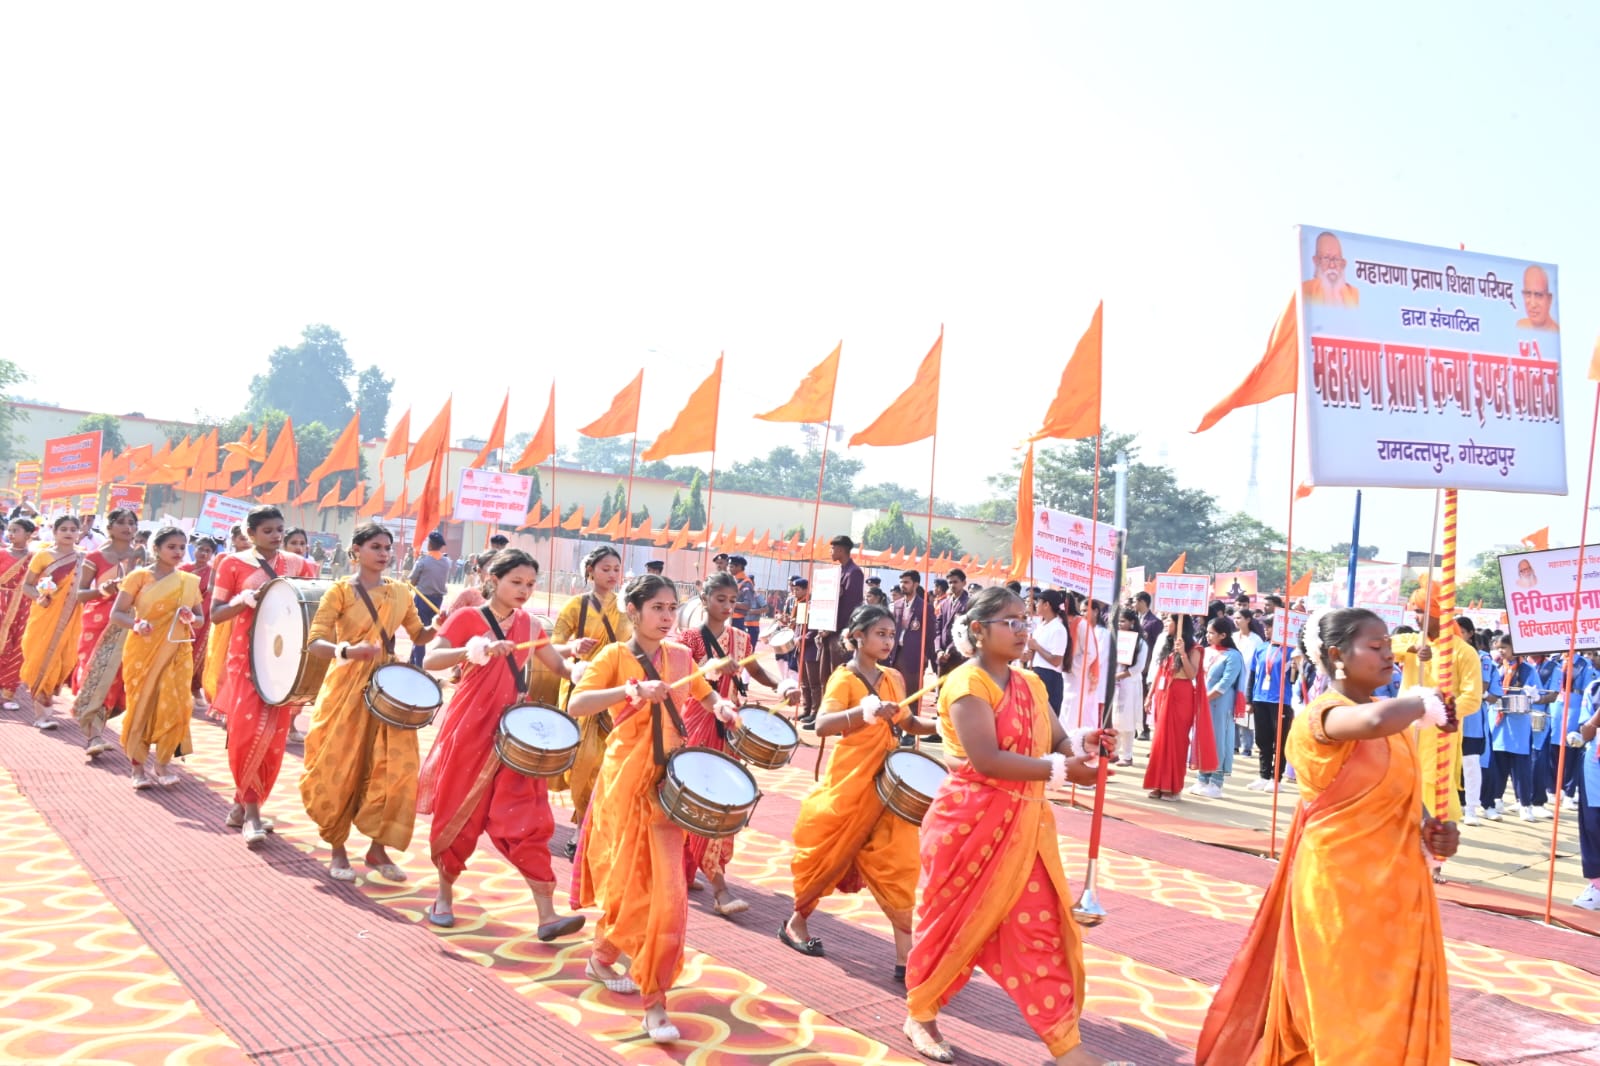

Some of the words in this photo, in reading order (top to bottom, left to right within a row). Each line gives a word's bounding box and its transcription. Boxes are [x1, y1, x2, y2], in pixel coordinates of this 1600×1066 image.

[1356, 261, 1408, 286] महाराणा
[1411, 269, 1443, 291] प्रताप
[1446, 265, 1475, 295] शिक्षा
[1401, 308, 1426, 327] द्वारा
[1429, 308, 1480, 333] संचालित
[1312, 336, 1382, 410] महाराणा
[1384, 344, 1428, 414] प्रताप
[1429, 349, 1472, 417] कन्या
[1511, 341, 1560, 424] कॉलेज
[1458, 438, 1516, 477] गोरखपुर
